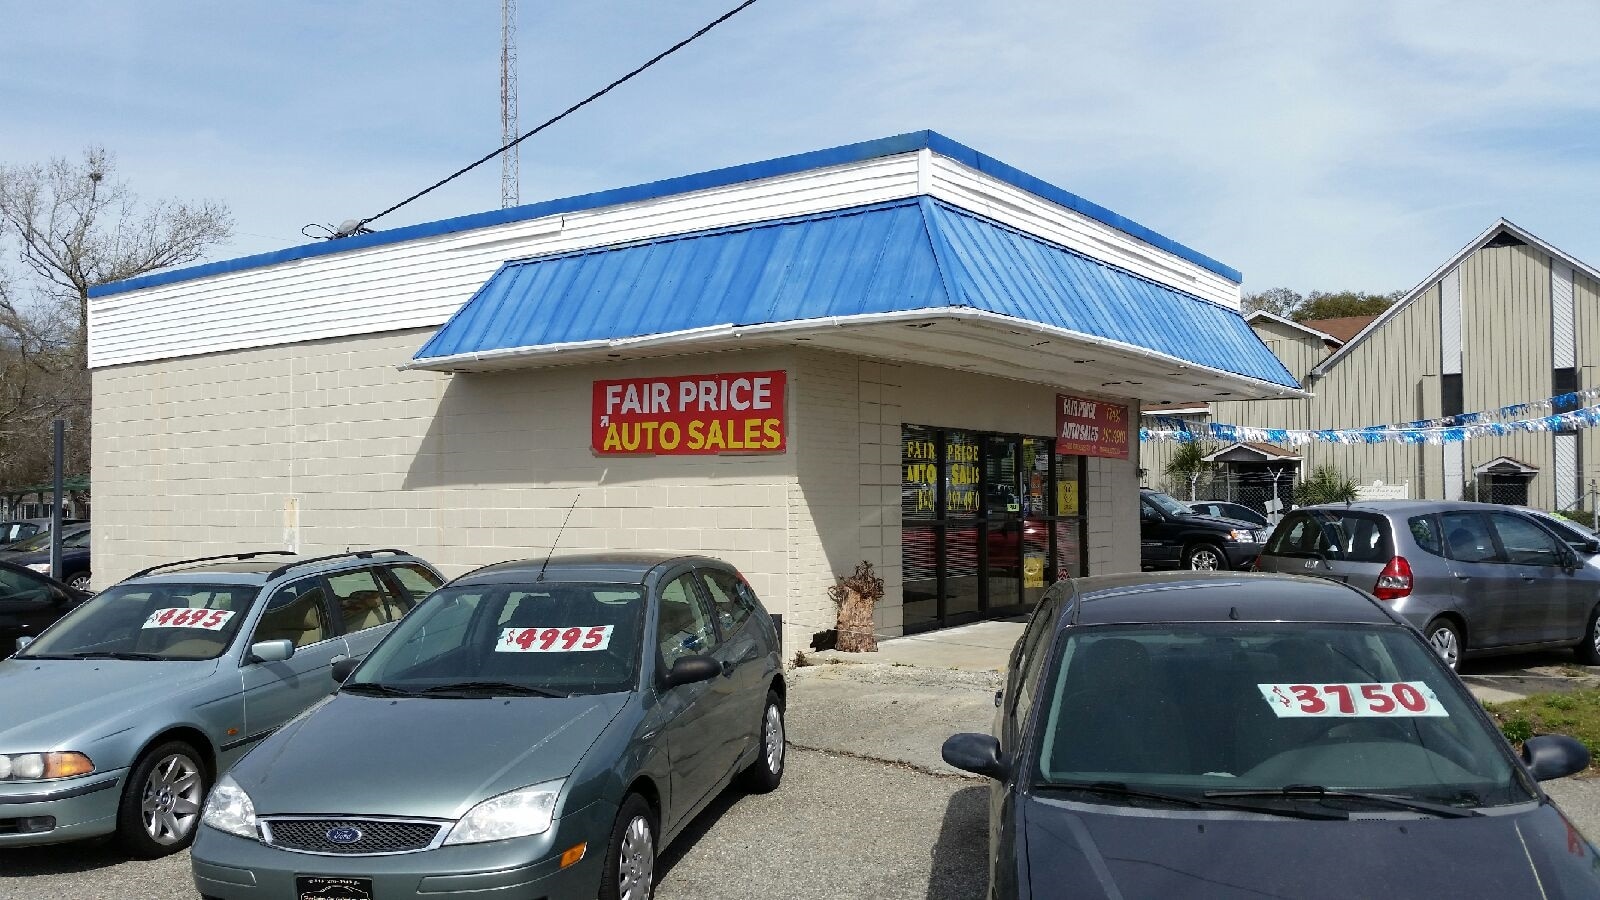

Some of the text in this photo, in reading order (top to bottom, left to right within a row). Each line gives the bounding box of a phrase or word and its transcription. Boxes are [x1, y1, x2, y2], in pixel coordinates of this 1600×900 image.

[606, 377, 772, 415] FAIR PRICE
[603, 418, 781, 451] AUTO SALES
[1080, 424, 1099, 442] SALES
[907, 441, 979, 462] FAIR PRICE
[907, 463, 936, 484] AUTO
[506, 626, 606, 650] $4995
[1272, 683, 1428, 714] $3750
[333, 830, 353, 840] Ford
